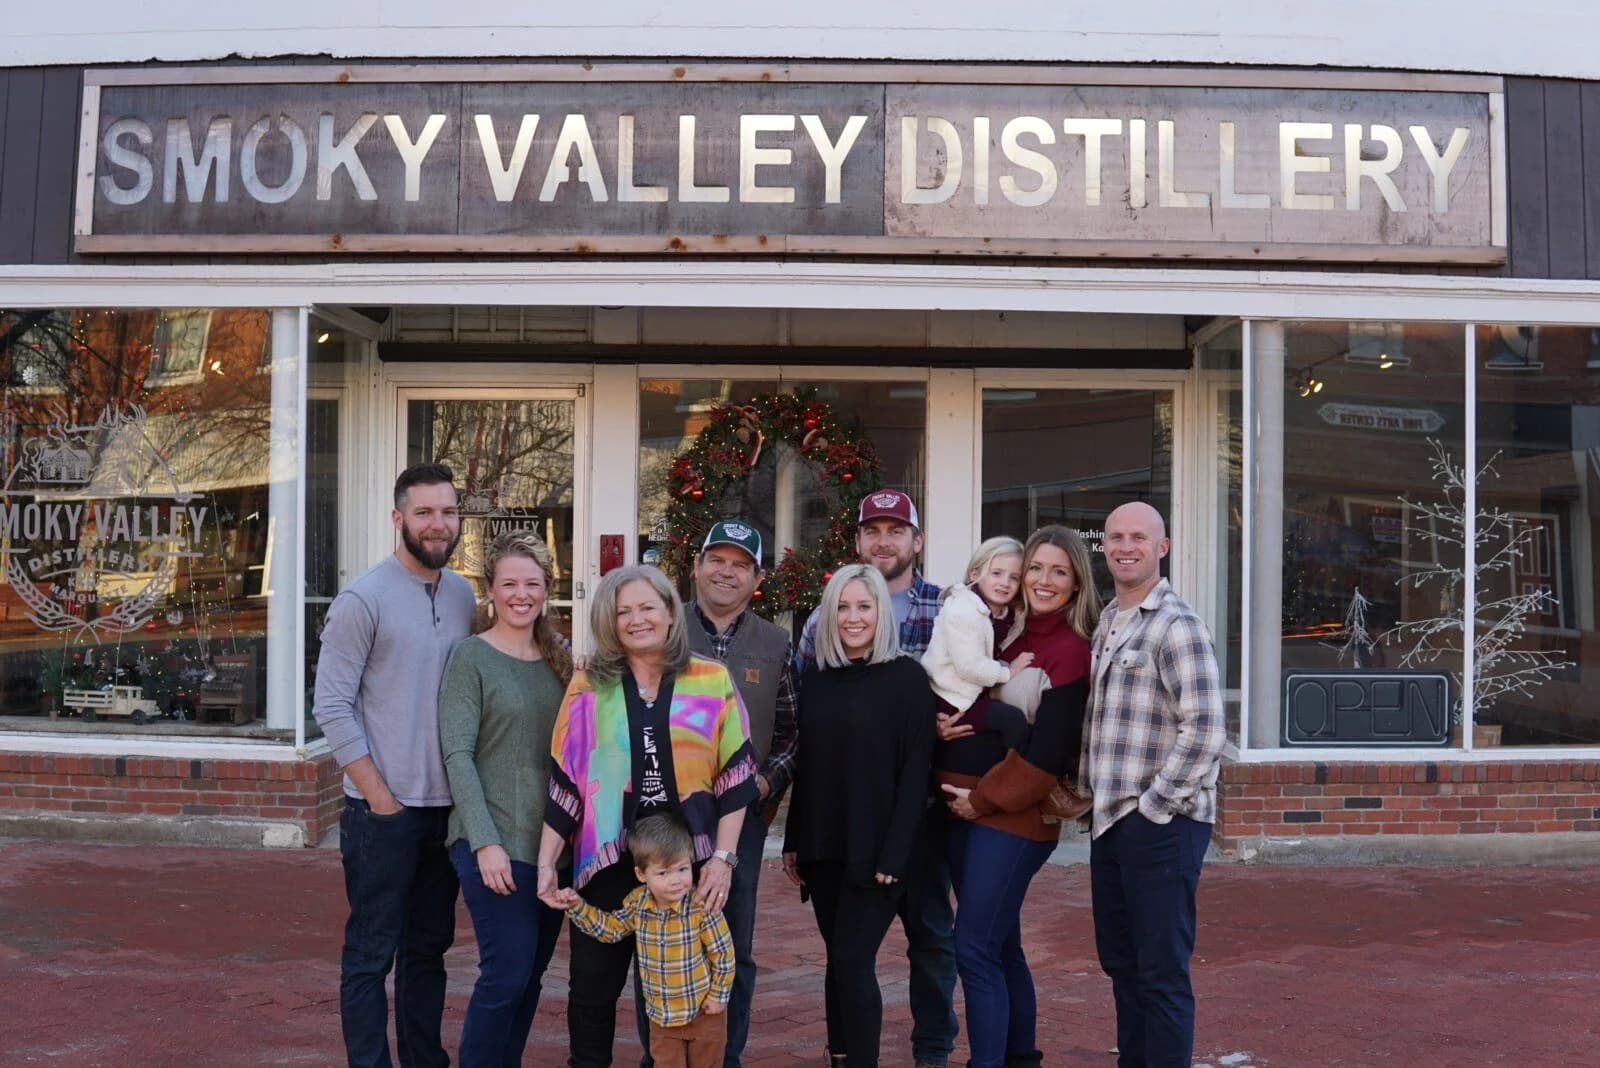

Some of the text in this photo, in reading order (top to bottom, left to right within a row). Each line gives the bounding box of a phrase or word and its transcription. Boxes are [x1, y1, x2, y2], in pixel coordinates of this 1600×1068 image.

[101, 112, 1471, 213] SMOKY VALLEY DISTILLERY
[94, 504, 209, 544] VALLEY
[1295, 681, 1442, 737] OPEN
